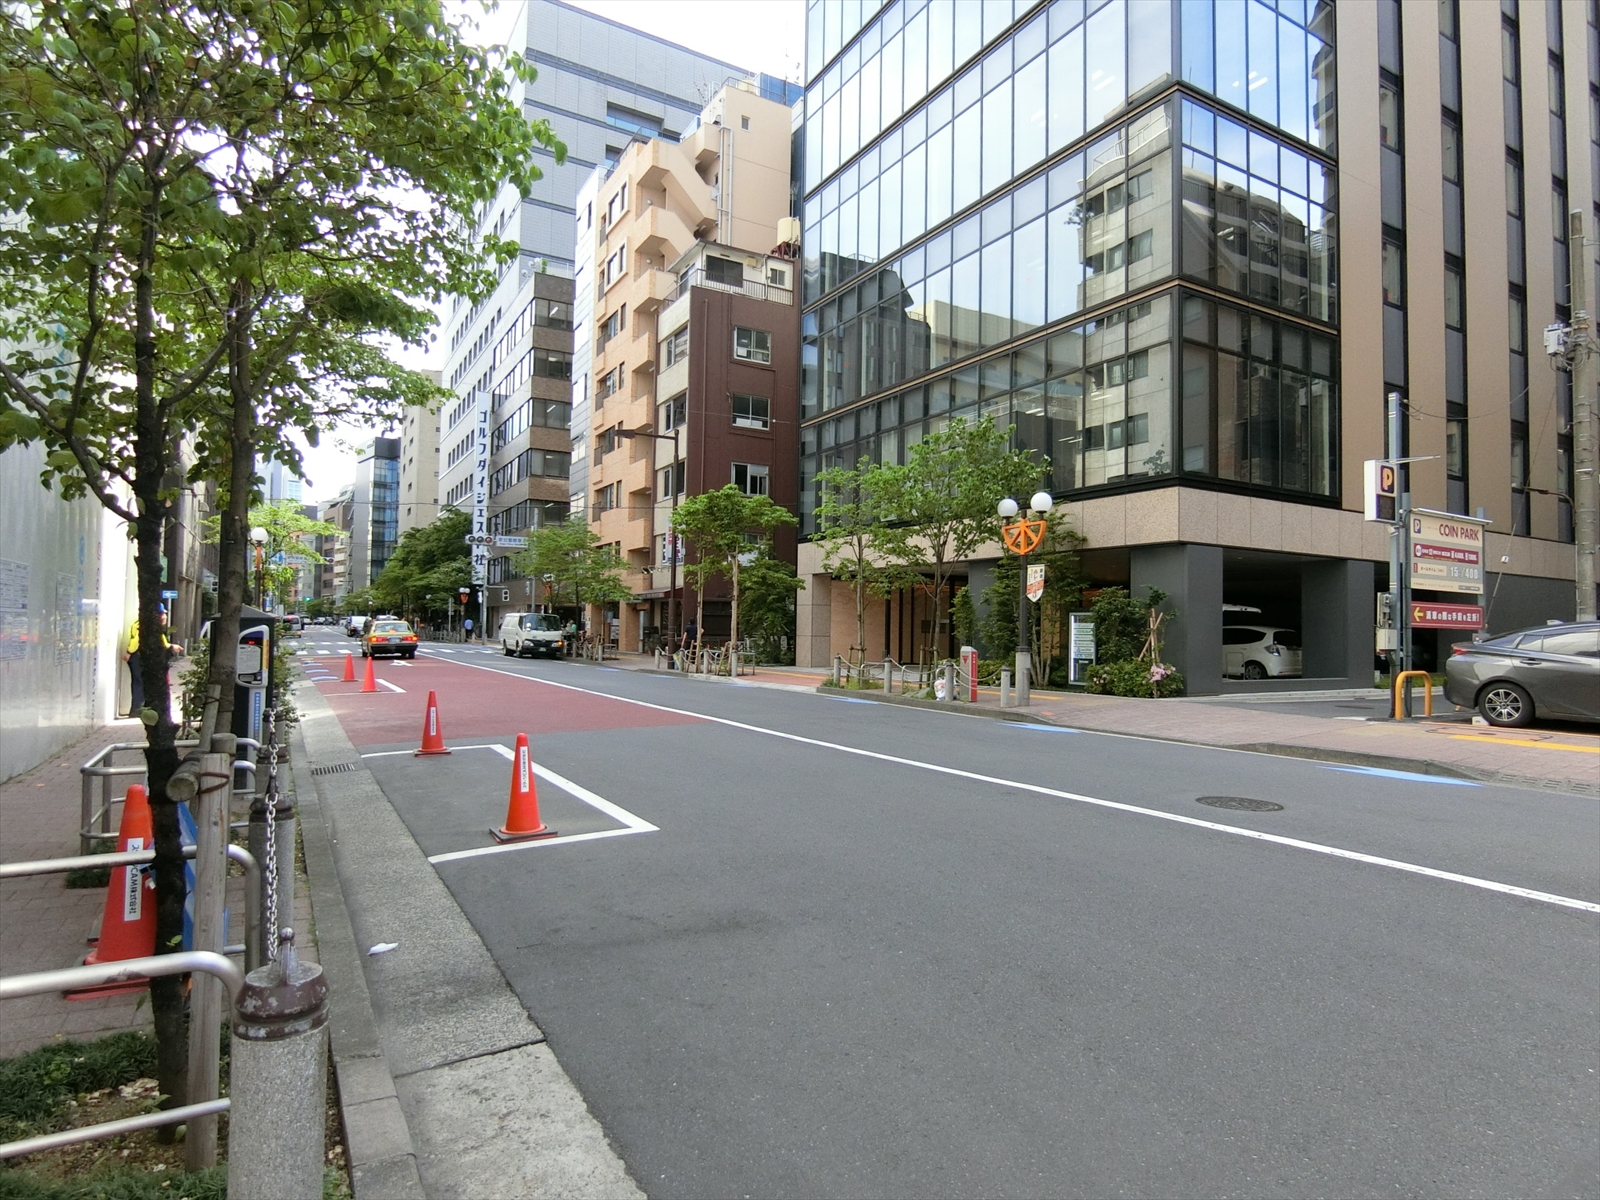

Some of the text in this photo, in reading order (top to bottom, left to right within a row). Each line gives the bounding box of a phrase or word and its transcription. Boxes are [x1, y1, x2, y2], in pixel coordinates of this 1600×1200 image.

[474, 410, 488, 566] ゴルフダイジェス社
[1382, 467, 1393, 490] P
[1439, 524, 1480, 541] COIN PARK
